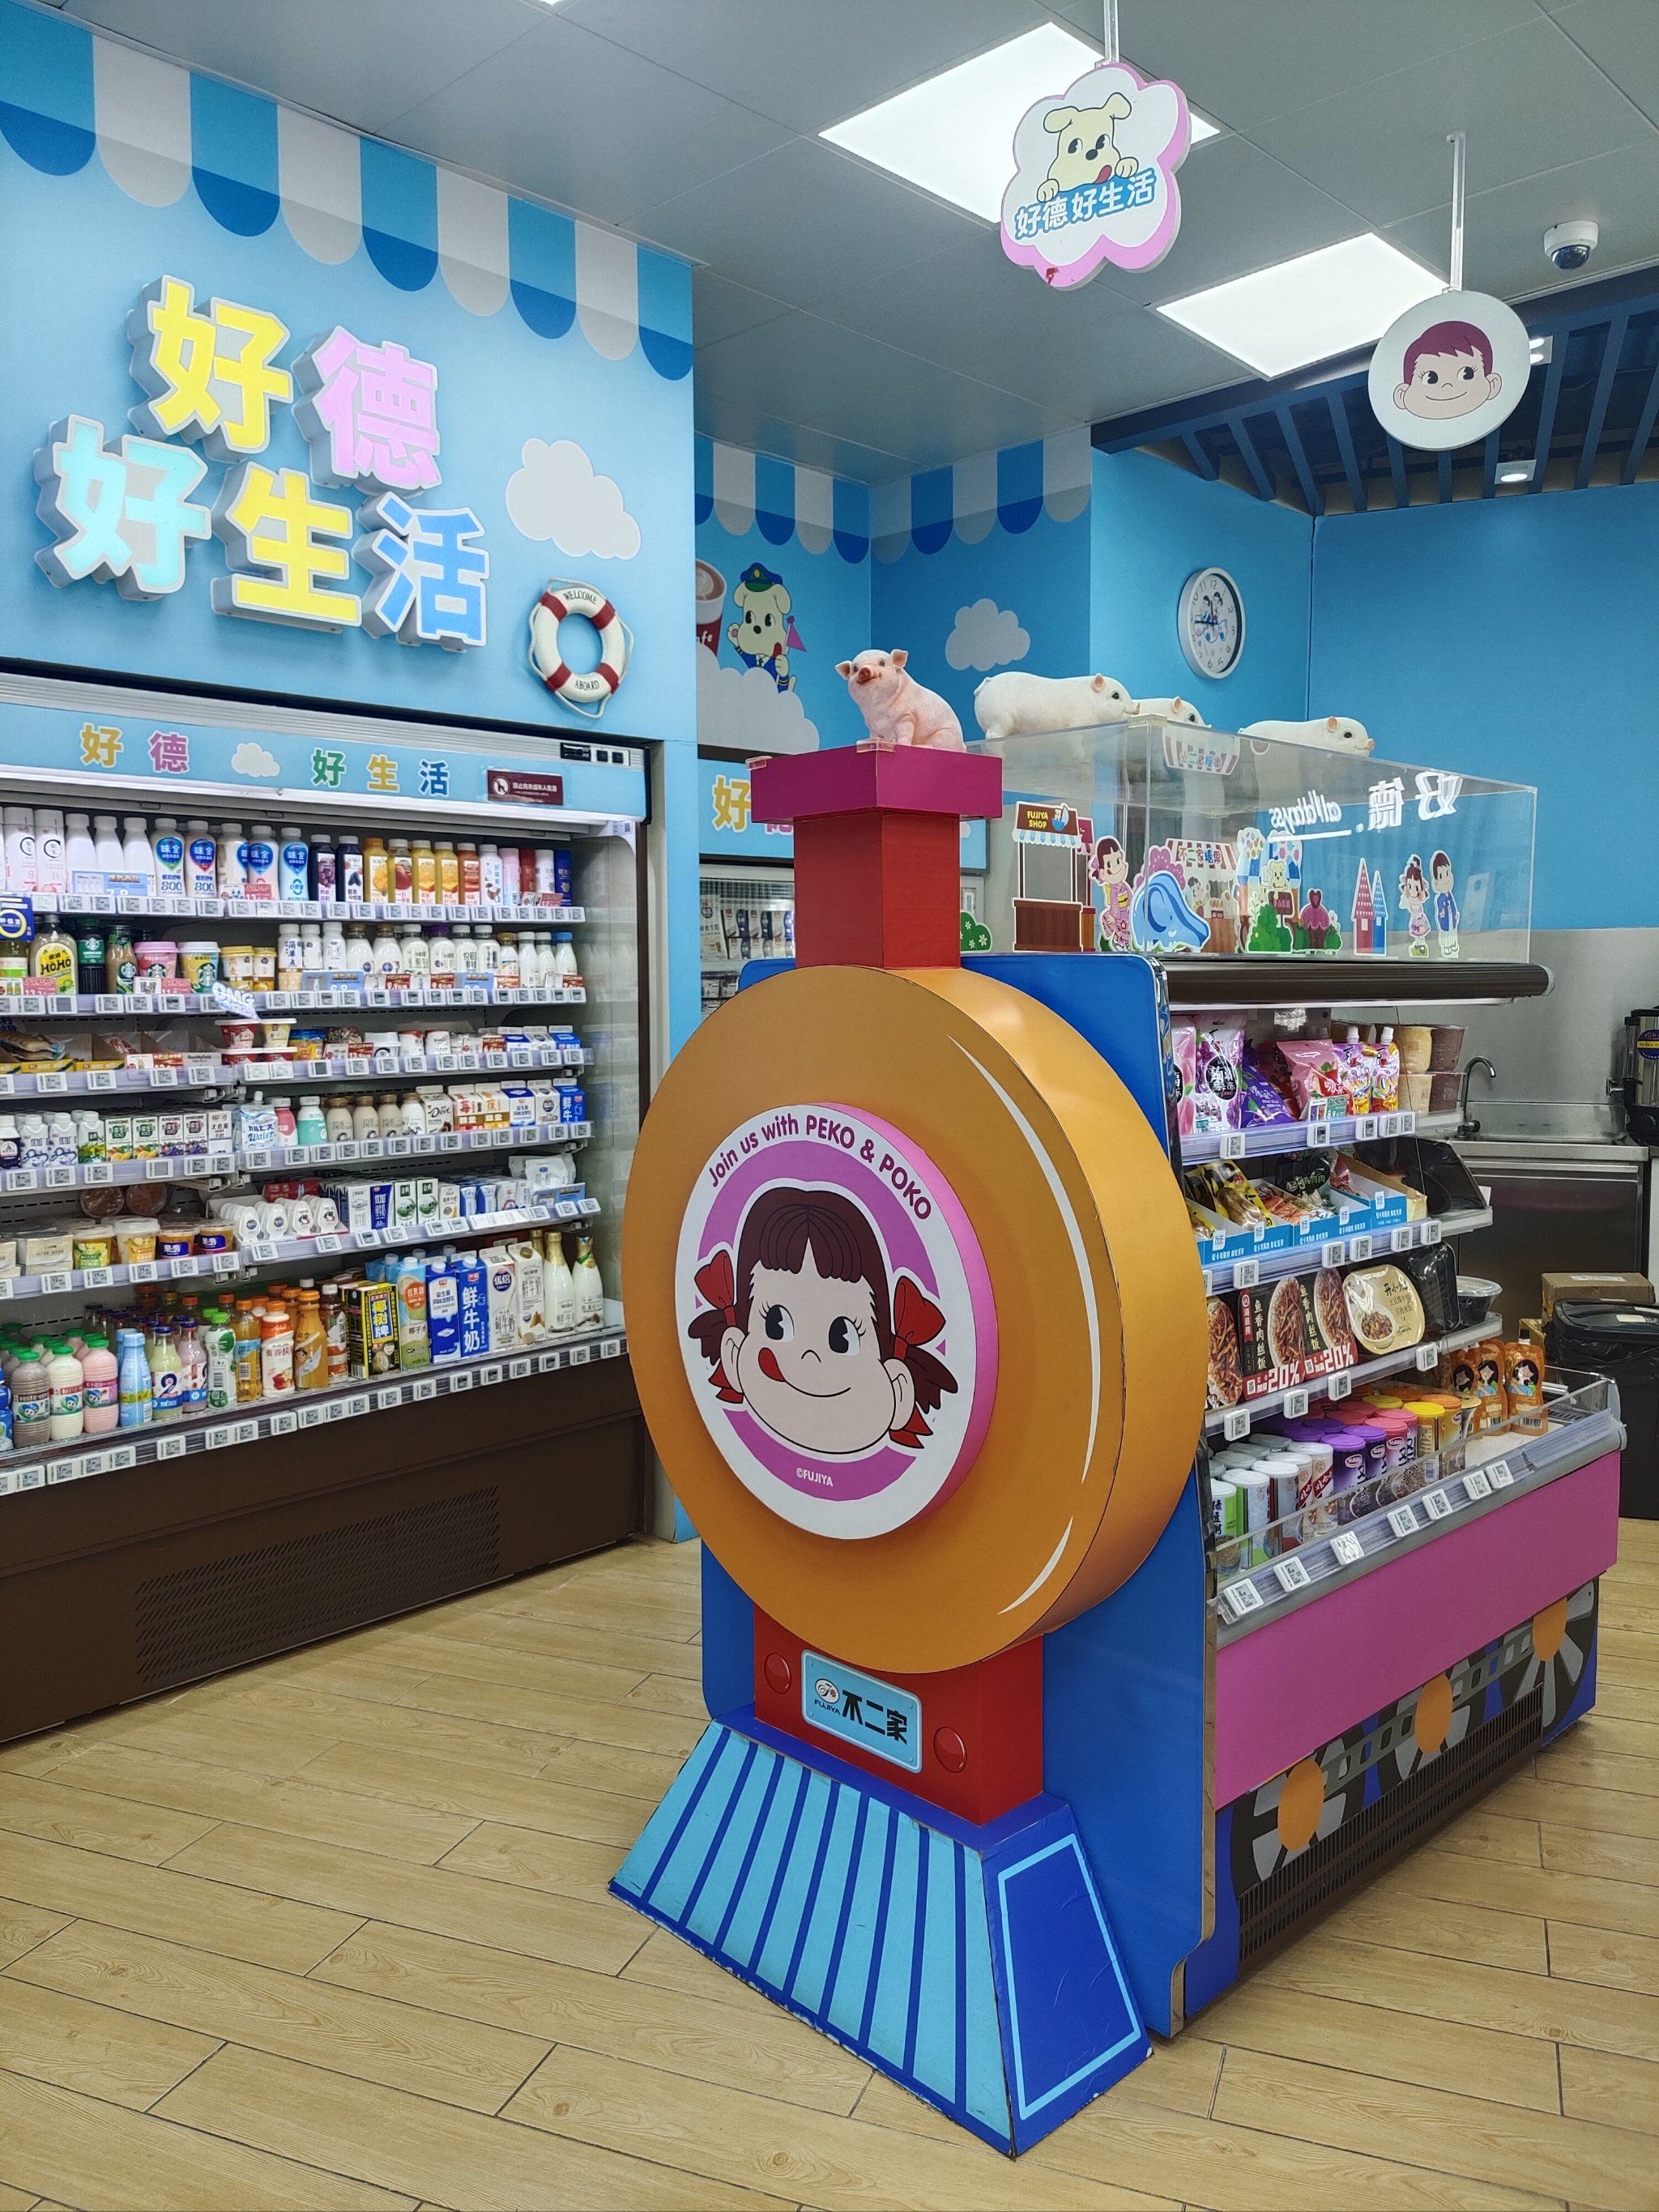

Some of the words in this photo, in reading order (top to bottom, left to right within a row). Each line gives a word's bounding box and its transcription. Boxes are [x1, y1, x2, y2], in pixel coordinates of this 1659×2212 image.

[1015, 169, 1157, 240] 好德好生活
[147, 275, 442, 489] 好德
[53, 414, 491, 647] 好生活
[563, 590, 598, 605] WELCOME
[574, 680, 600, 692] ABOARD
[81, 723, 190, 774] 好德
[312, 748, 450, 796] 好生活
[1026, 811, 1048, 820] FUJIYA
[1028, 820, 1047, 829] SHOP
[160, 845, 180, 855] 味全
[194, 846, 213, 855] 味全
[250, 850, 270, 859] 味全
[288, 851, 305, 859] 味全
[432, 1106, 451, 1118] Dove
[710, 1149, 739, 1187] Join
[739, 1132, 759, 1155] us
[761, 1114, 800, 1139] with
[806, 1115, 855, 1150] PEKO
[859, 1138, 875, 1163] &
[878, 1153, 932, 1221] POKO
[463, 1286, 480, 1353] 鲜牛奶
[1300, 1284, 1321, 1350] 鱼香肉丝饭
[1254, 1298, 1267, 1370] 鱼香肉丝饭
[1323, 1343, 1354, 1373] 20%
[1269, 1361, 1300, 1393] 20%
[814, 1698, 841, 1716] FUJIYA
[842, 1690, 907, 1745] 不二家
